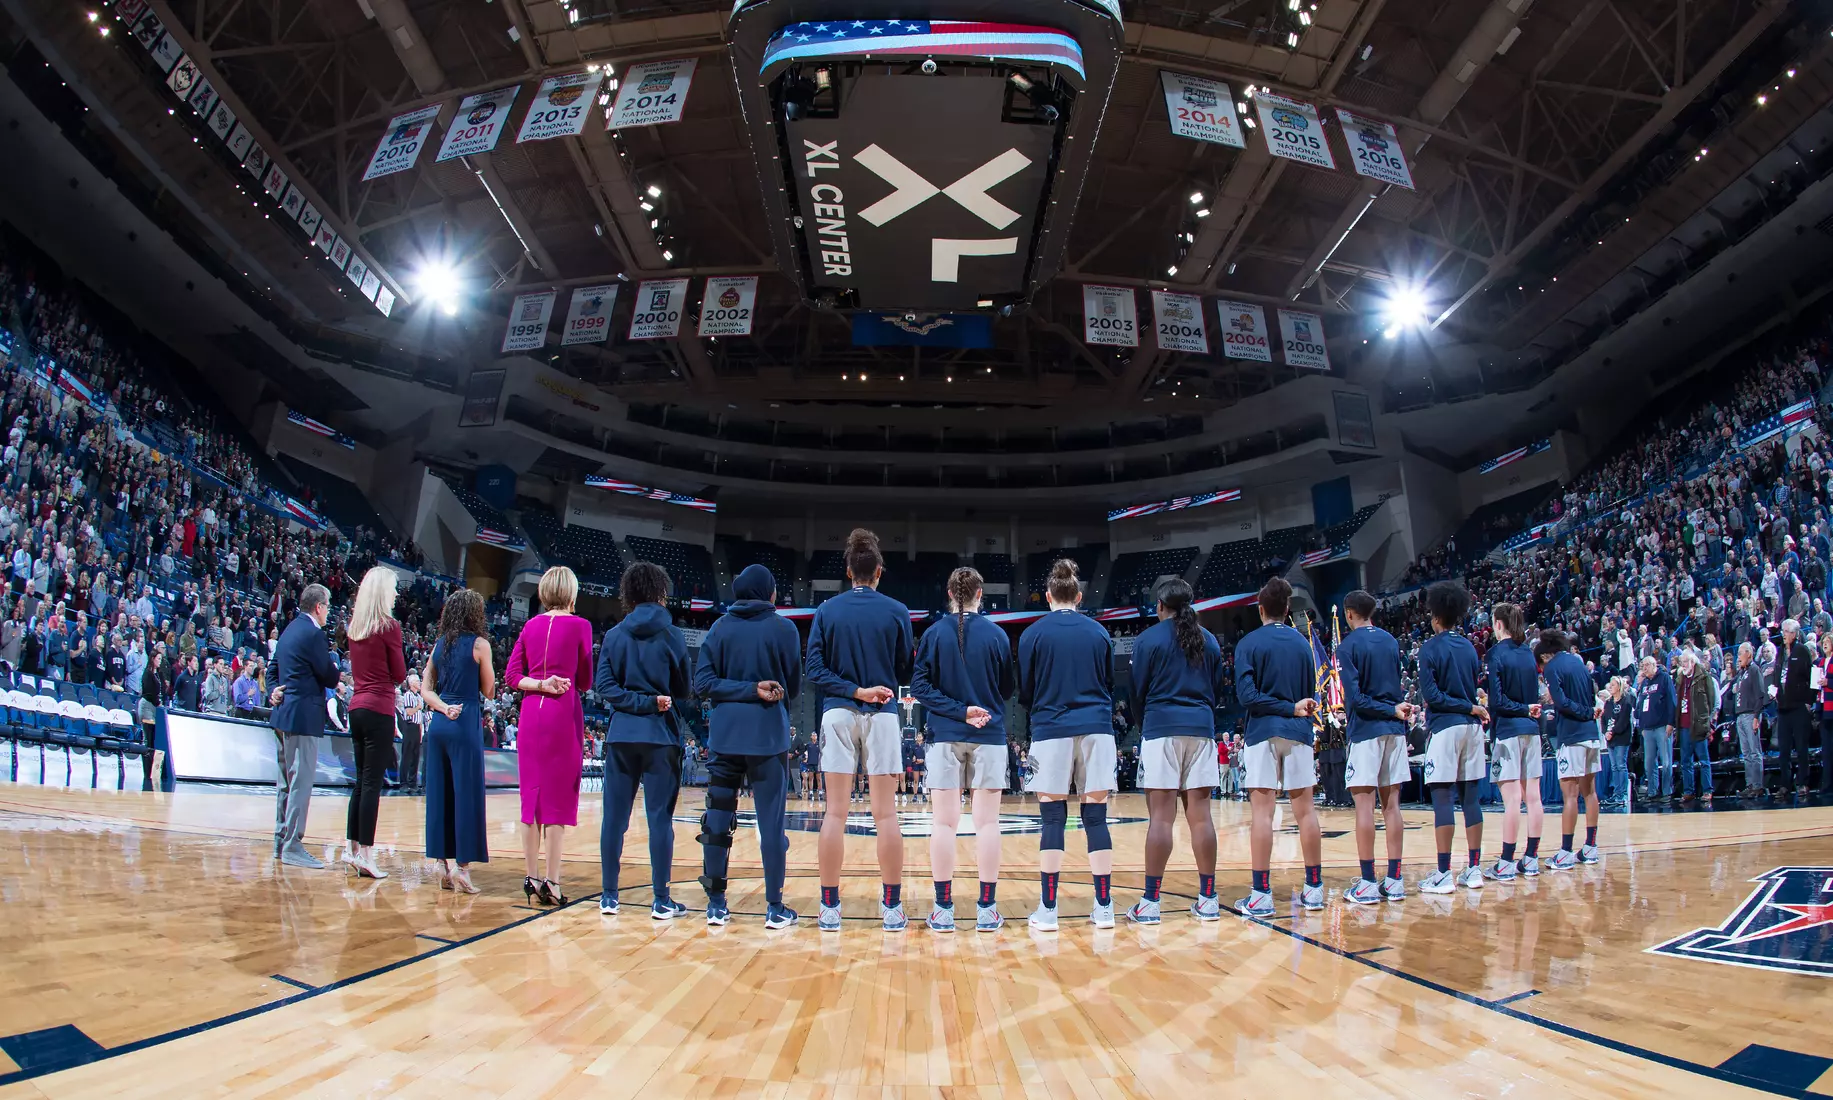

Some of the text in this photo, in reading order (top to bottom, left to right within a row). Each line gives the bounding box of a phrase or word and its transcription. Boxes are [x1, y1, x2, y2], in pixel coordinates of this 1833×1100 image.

[622, 93, 677, 111] 2014
[531, 106, 582, 125] 2013
[621, 108, 671, 119] NATIONAL
[1177, 107, 1231, 129] 2014
[529, 121, 574, 132] NATIONAL
[615, 115, 673, 127] CHAMPIONS
[452, 123, 495, 143] 2011
[522, 128, 575, 140] CHAMPIONS
[1182, 122, 1231, 136] NATIONAL
[448, 137, 489, 150] NATIONAL
[1180, 129, 1237, 144] CHAMPIONS
[1271, 128, 1321, 150] 2015
[375, 142, 418, 163] 2010
[441, 144, 489, 159] CHAMPIONS
[1277, 142, 1323, 157] NATIONAL
[374, 157, 409, 169] NATIONAL
[1275, 149, 1329, 166] CHAMPIONS
[1357, 147, 1402, 170] 2016
[368, 163, 410, 178] CHAMPIONS
[1363, 162, 1403, 177] NATIONAL
[1362, 169, 1409, 186] CHAMPIONS
[803, 139, 852, 276] XL CENTER
[634, 311, 679, 324] 2000
[704, 308, 749, 321] 2002
[511, 323, 543, 337] 1995
[570, 316, 606, 330] 1999
[1089, 317, 1133, 331] 2003
[1094, 330, 1130, 339] NATIONAL
[1159, 323, 1203, 338] 2004
[565, 336, 602, 344] CHAMPIONS
[1091, 337, 1134, 345] CHAMPIONS
[1165, 337, 1200, 345] NATIONAL
[1225, 332, 1267, 348] 2004
[1162, 343, 1203, 352] CHAMPIONS
[1231, 345, 1264, 353] NATIONAL
[1286, 340, 1324, 355] 2009
[1229, 351, 1268, 360] CHAMPIONS
[1291, 353, 1323, 362] NATIONAL
[1290, 359, 1326, 369] CHAMPIONS
[1240, 522, 1252, 530] 229
